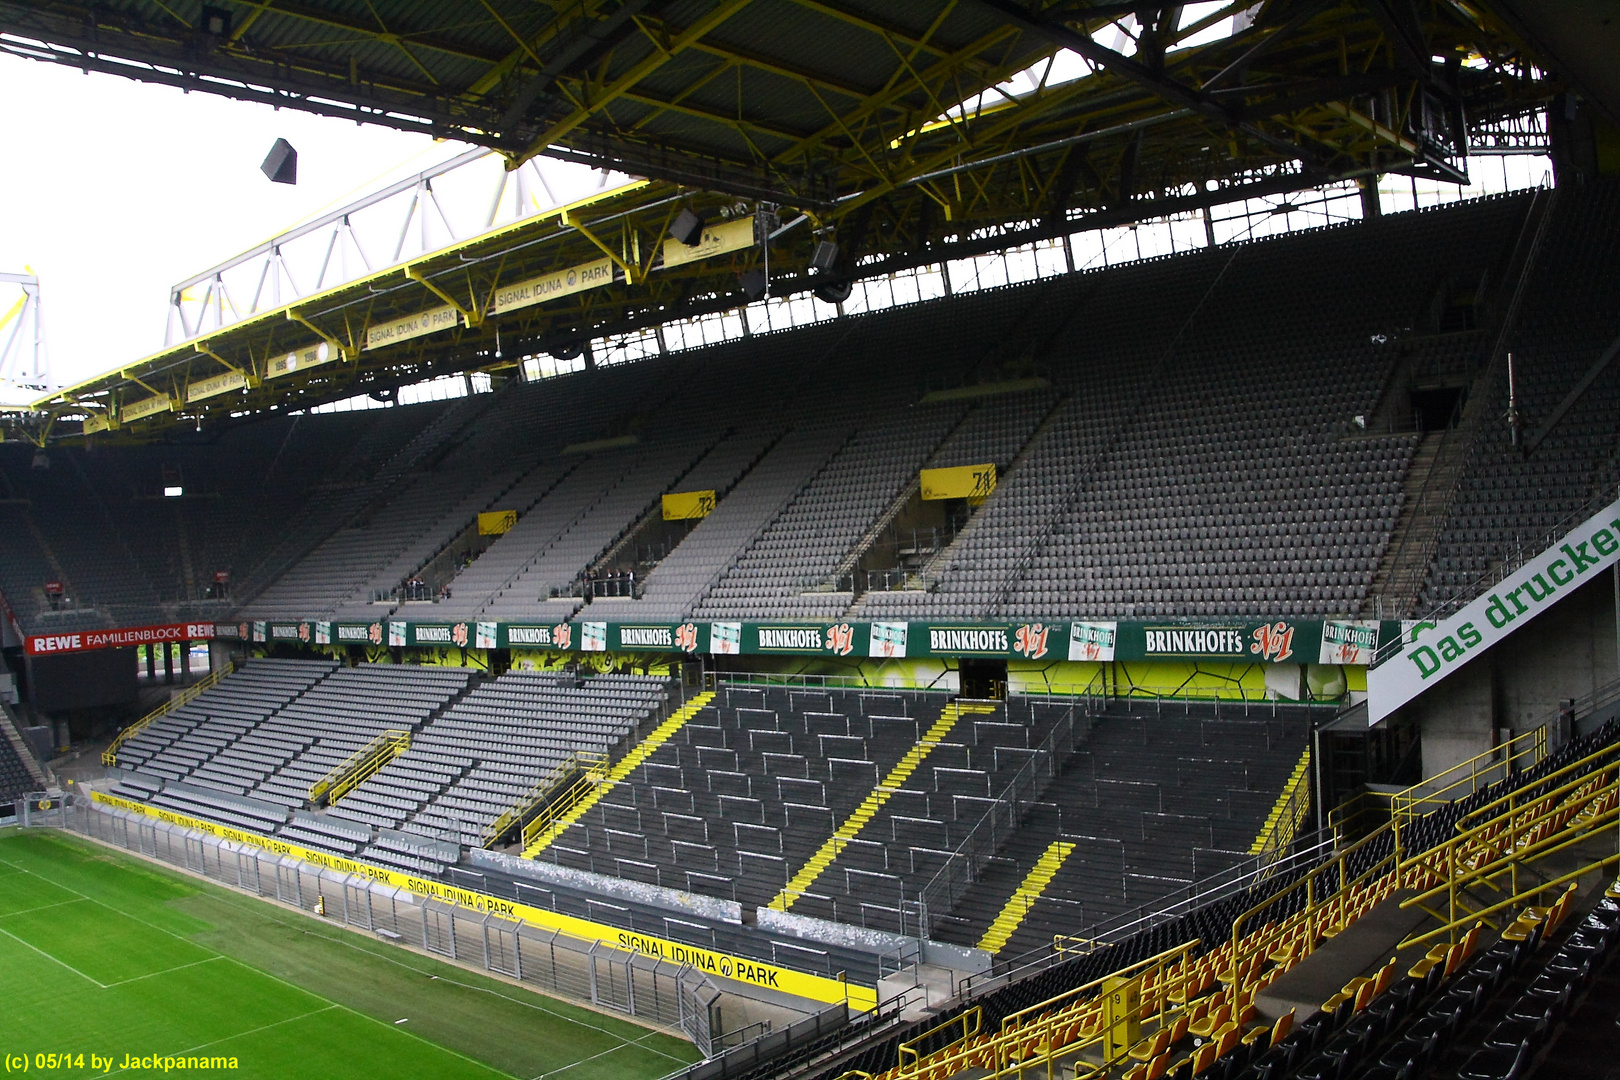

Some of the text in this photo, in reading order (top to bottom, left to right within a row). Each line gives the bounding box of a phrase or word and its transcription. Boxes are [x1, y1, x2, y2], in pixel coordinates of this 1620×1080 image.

[498, 264, 609, 306] SIGNAL IDUNA PARK
[370, 310, 454, 344] SIGNAL IDUNA PARK
[972, 471, 990, 490] 71
[699, 497, 712, 512] 72
[1407, 518, 1620, 680] Das drucke
[34, 623, 214, 653] REWE FAMILIENBLOCK REWE
[416, 628, 450, 642] BRINKHOFF's
[508, 628, 550, 644] BRINKHOFF's
[620, 628, 672, 646] BRINKHOFF's
[758, 630, 822, 648] BRINKHOFF's
[930, 630, 1008, 650] BRINKHOFF's
[1072, 624, 1114, 648] BRINKHOFF's
[1146, 630, 1242, 653] BRINKHOFF's
[1324, 622, 1376, 646] BRINKHOFF's
[201, 822, 216, 836] PARK
[273, 841, 292, 854] PARK
[368, 868, 390, 884] PARK
[488, 897, 514, 916] PARK
[618, 933, 779, 988] SIGNAL IDUNA PARK
